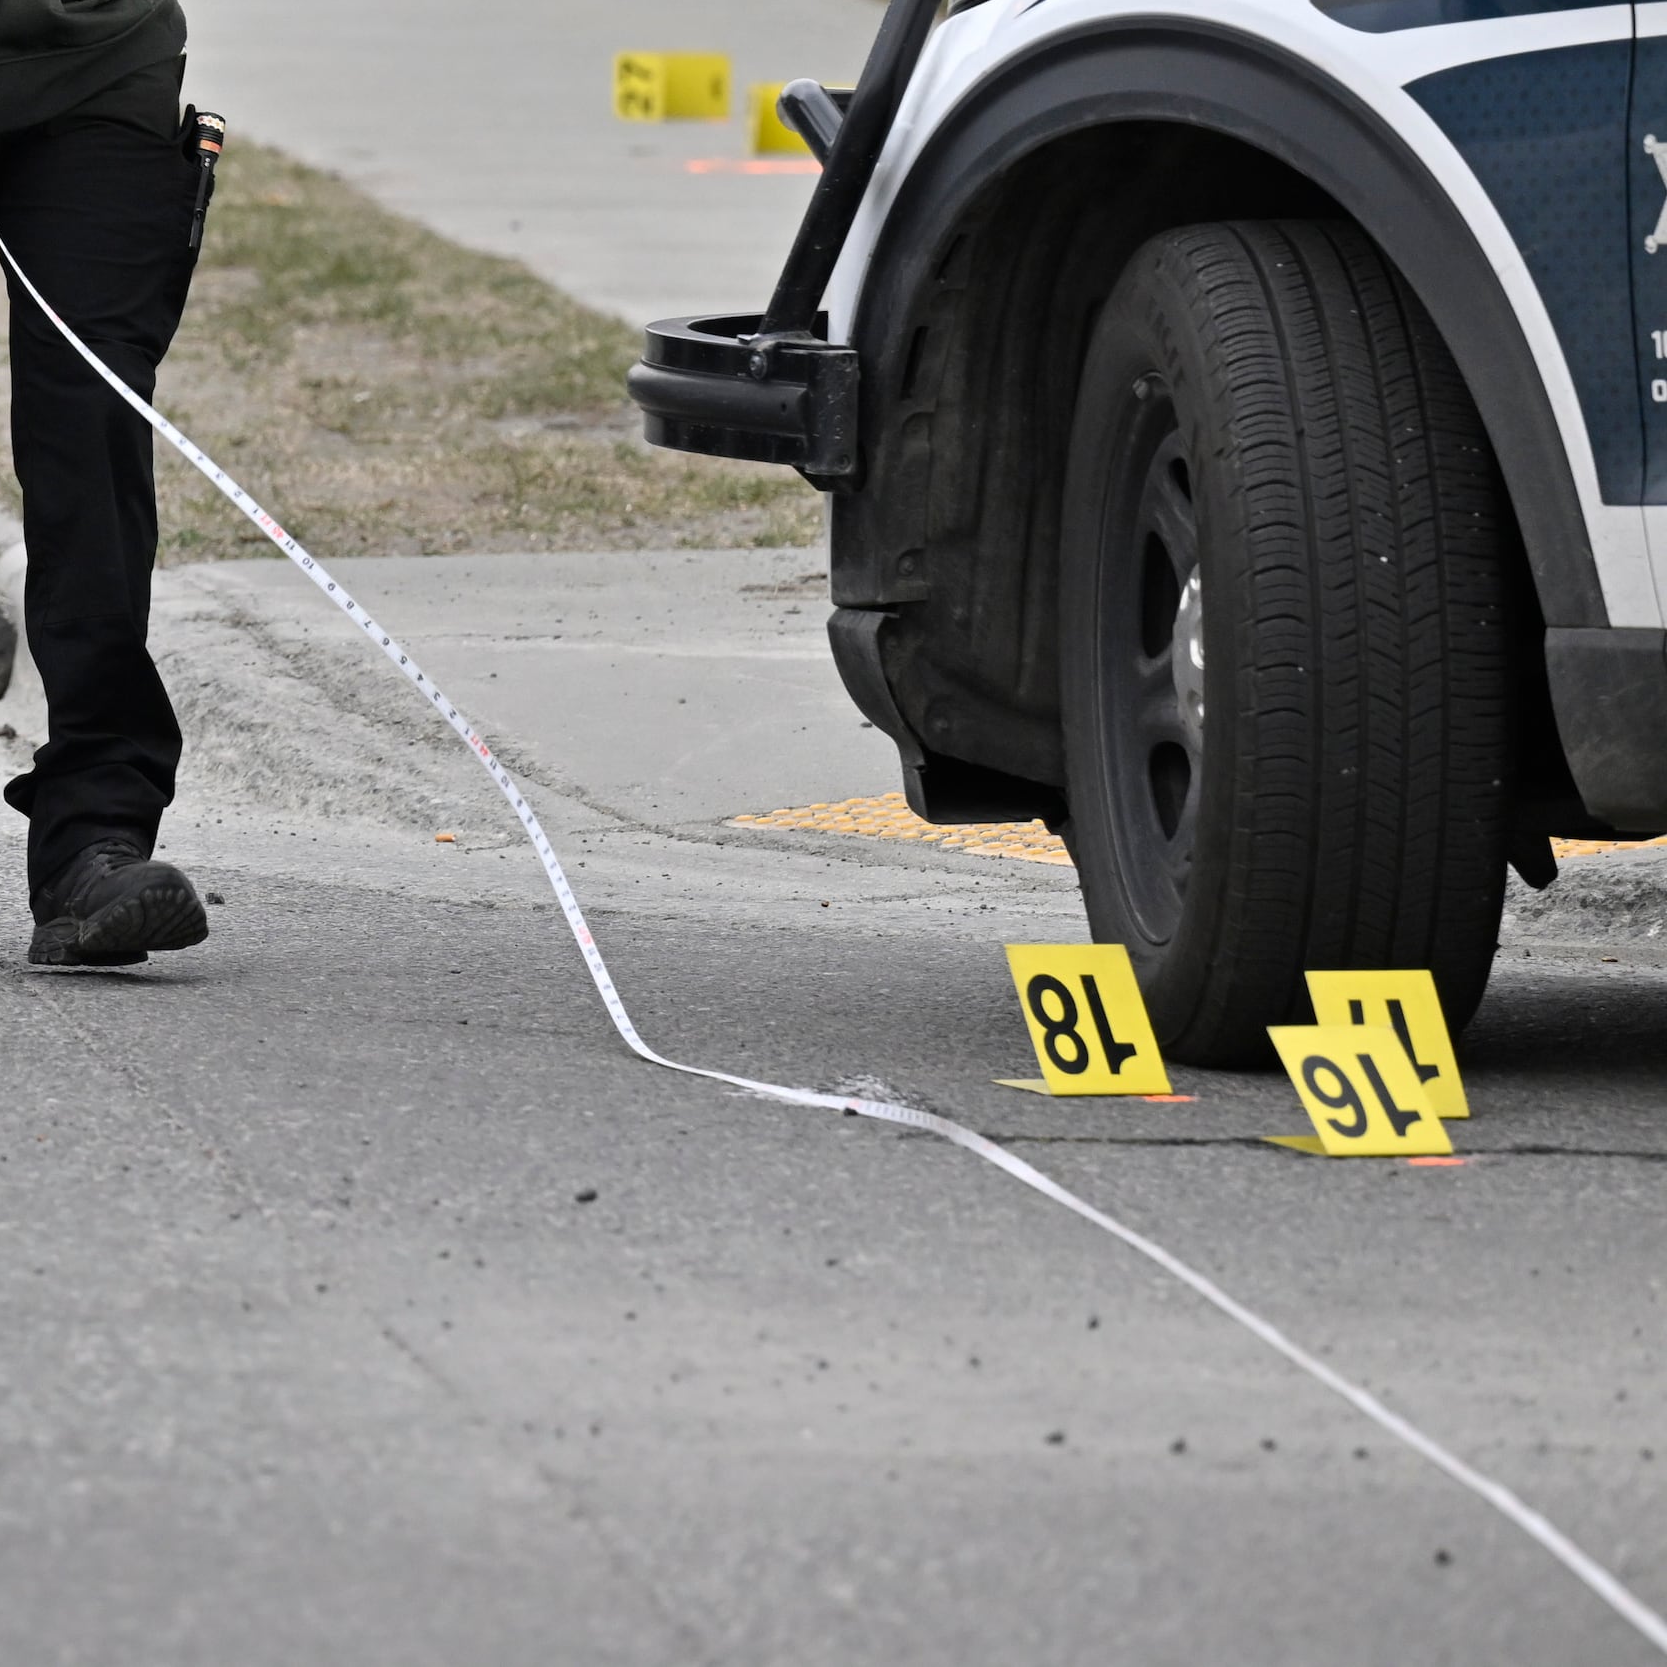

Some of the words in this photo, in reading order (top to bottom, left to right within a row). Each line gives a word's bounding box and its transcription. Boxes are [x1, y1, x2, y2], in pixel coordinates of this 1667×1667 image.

[302, 557, 315, 570] 10
[1027, 974, 1137, 1075] 18
[1301, 1053, 1423, 1138] 16
